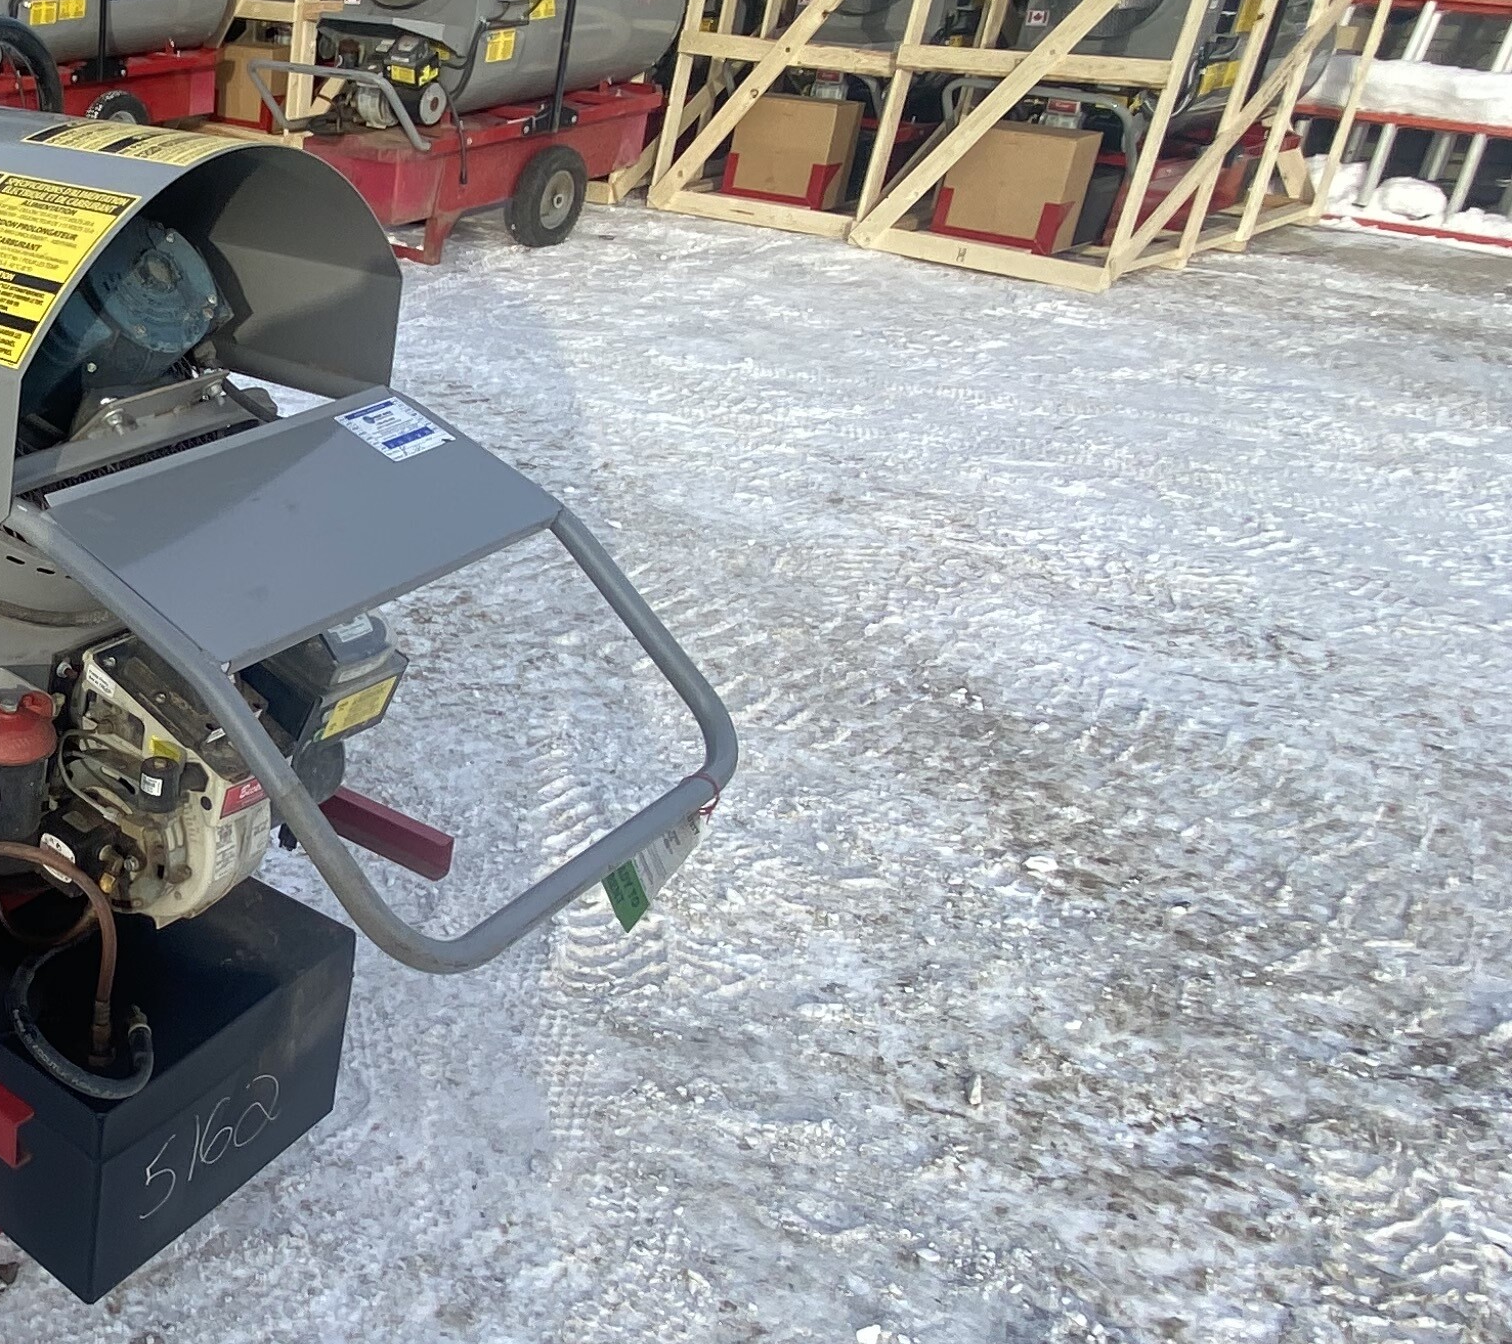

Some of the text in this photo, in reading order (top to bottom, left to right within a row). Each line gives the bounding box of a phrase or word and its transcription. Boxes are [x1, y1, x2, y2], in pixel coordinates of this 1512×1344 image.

[21, 200, 78, 216] ALIMENTATION
[17, 222, 79, 241] PROLONGATEUR
[140, 1074, 282, 1219] 5162
